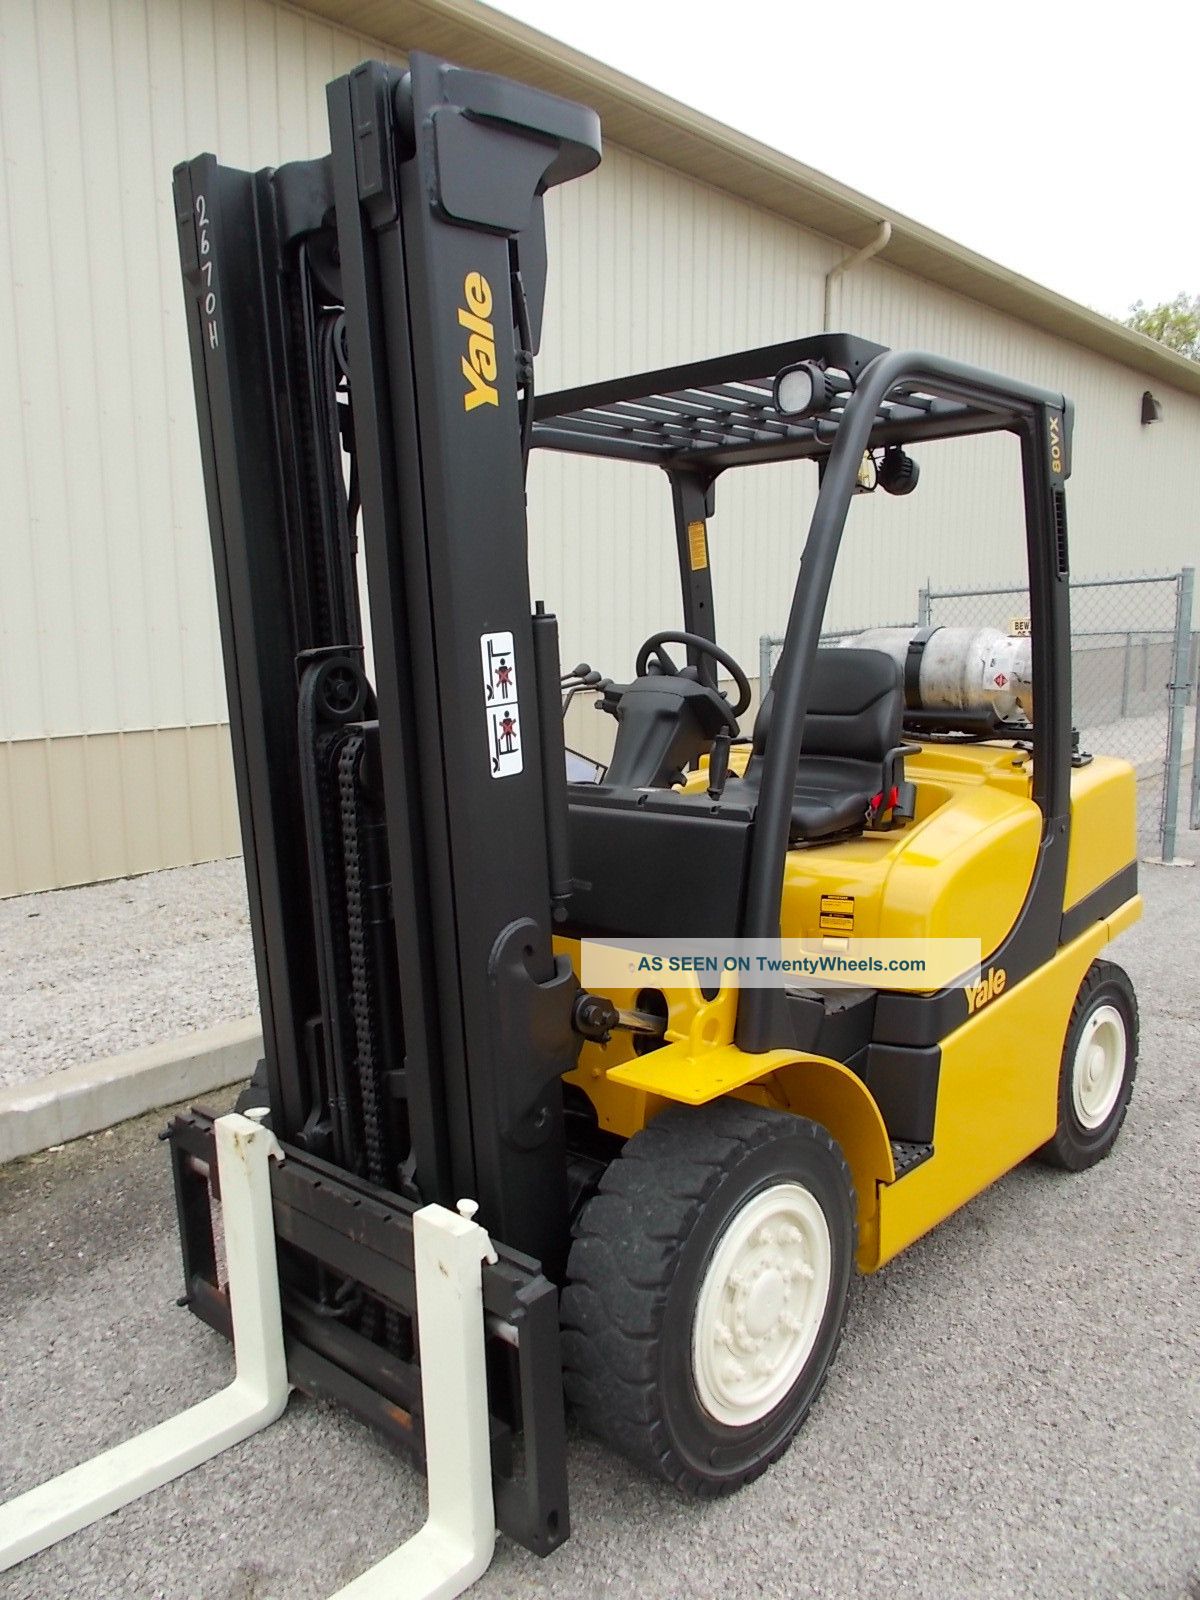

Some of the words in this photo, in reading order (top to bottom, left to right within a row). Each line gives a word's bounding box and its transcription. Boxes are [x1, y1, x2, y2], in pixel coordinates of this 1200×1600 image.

[458, 271, 499, 412] Yale
[1014, 621, 1031, 631] BEW
[964, 967, 1006, 1015] Yale
